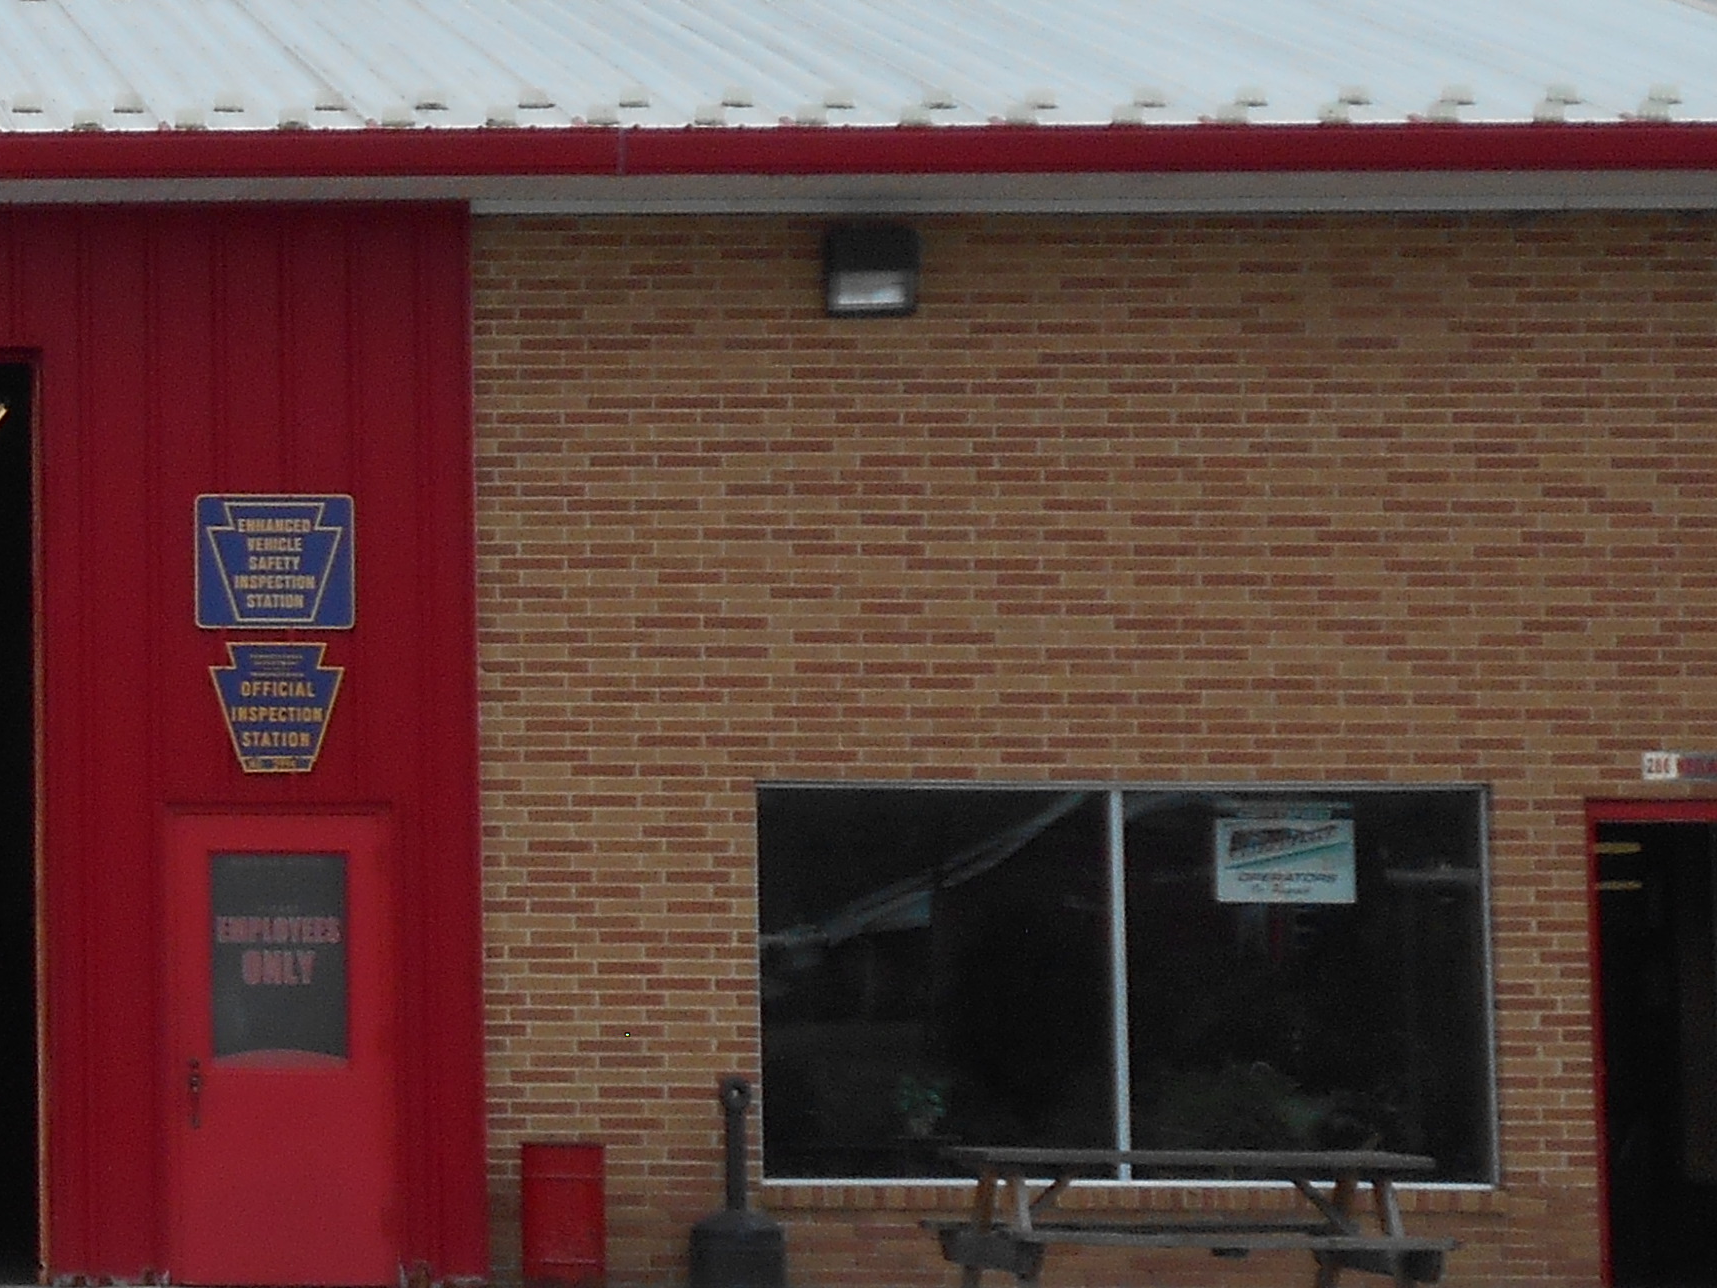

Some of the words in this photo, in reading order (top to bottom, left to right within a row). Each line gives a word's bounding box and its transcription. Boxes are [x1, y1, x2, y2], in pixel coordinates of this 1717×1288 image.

[237, 518, 312, 533] ENHANCED
[247, 537, 303, 552] VEHICLE
[248, 556, 301, 571] SAFETY
[234, 574, 315, 590] INSPECTION
[246, 593, 304, 609] STATION
[240, 681, 315, 697] OFFICIAL
[231, 706, 324, 723] INSPECTION
[241, 731, 311, 748] STATION
[216, 915, 341, 944] EMPLOYEES
[242, 949, 316, 986] ONLY
